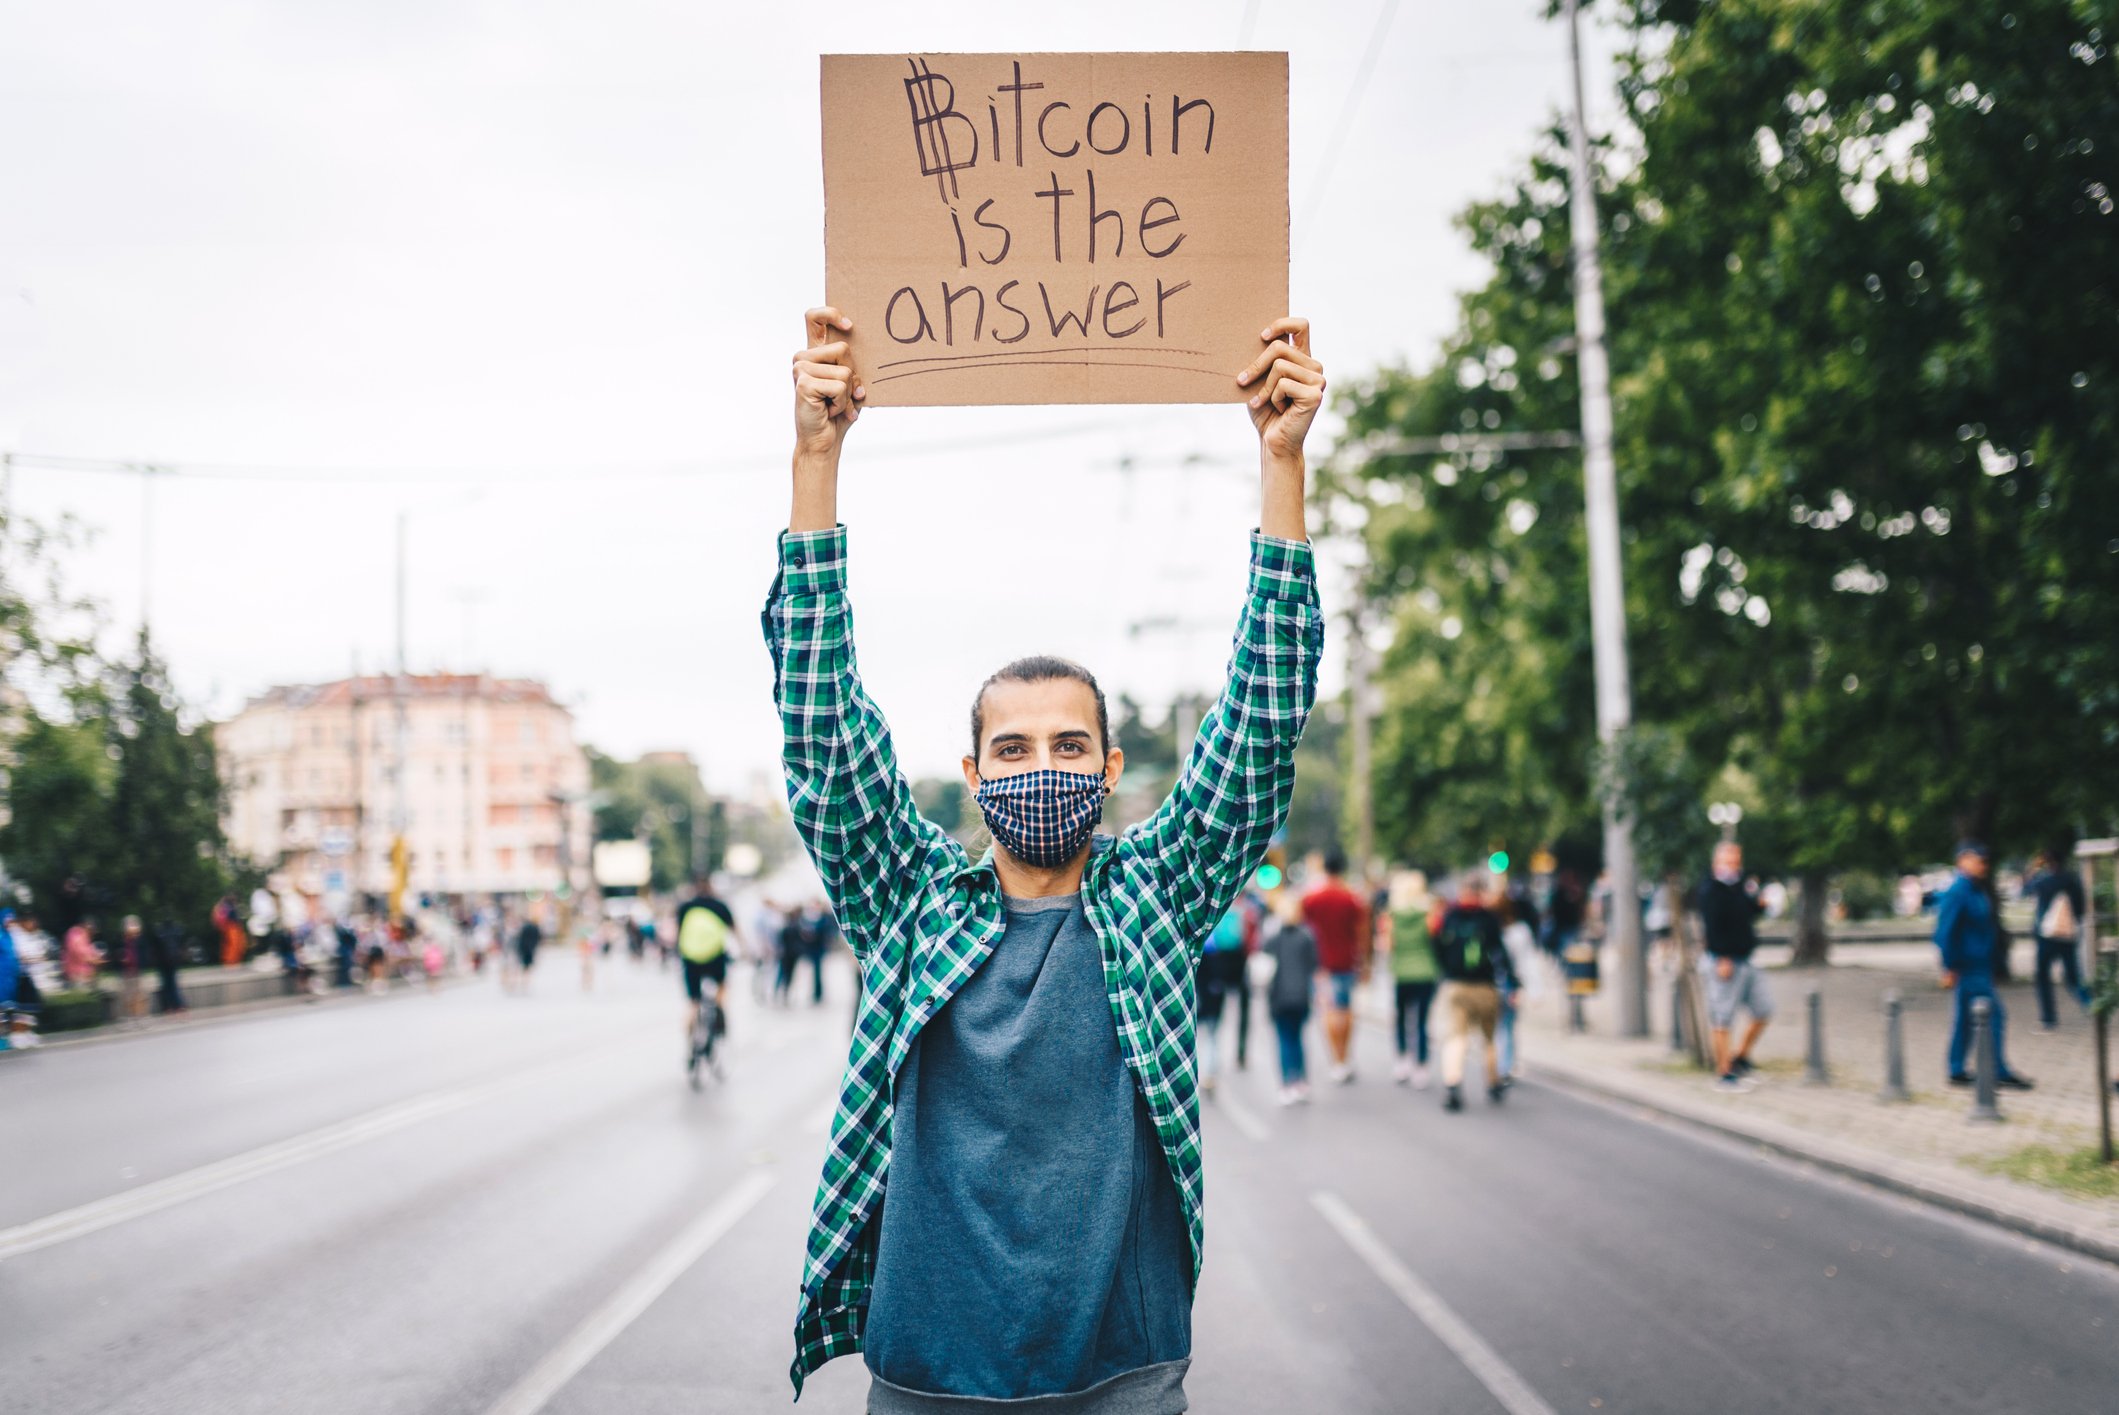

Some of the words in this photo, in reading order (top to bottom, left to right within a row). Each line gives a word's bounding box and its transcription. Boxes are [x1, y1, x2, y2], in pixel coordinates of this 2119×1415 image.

[950, 198, 1011, 268] is
[1034, 169, 1187, 264] the
[885, 278, 1192, 346] answer
